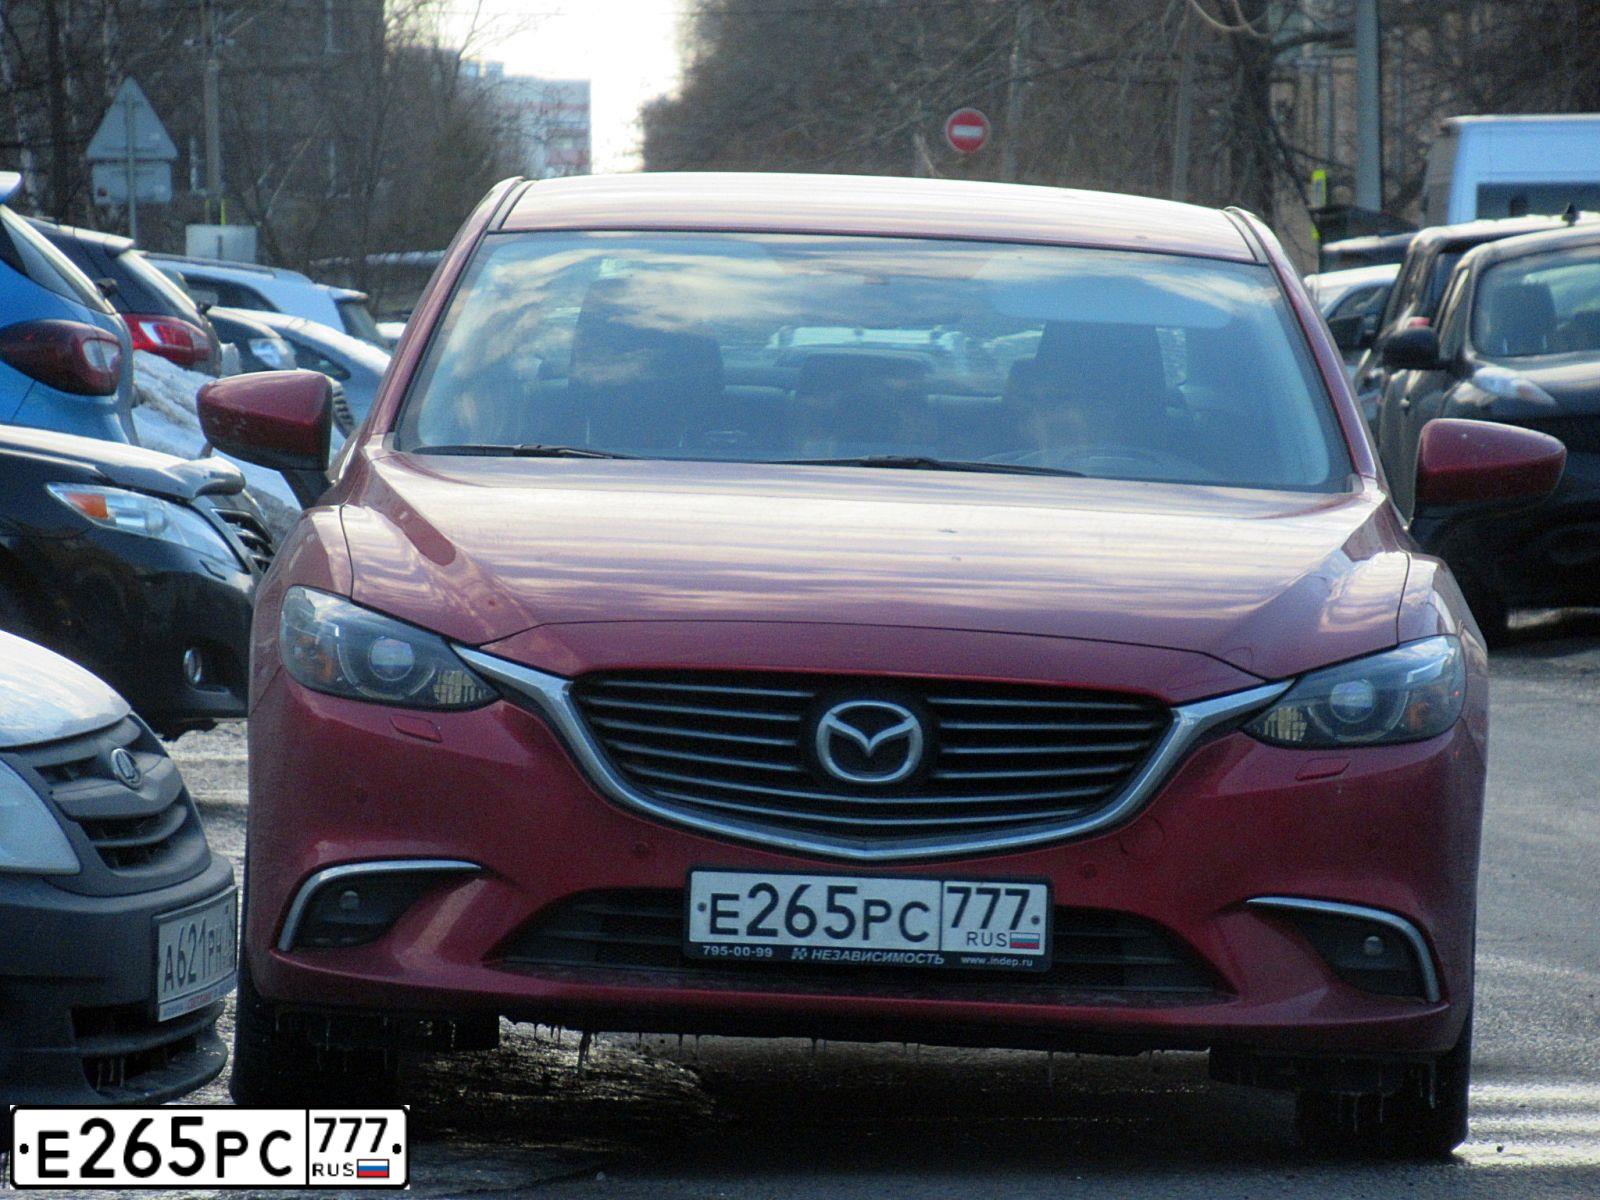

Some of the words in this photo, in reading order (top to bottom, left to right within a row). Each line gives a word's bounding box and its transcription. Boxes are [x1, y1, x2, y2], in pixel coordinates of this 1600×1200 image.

[709, 881, 931, 943] E265PC
[946, 886, 1031, 931] 777
[966, 931, 1008, 947] RUS
[702, 945, 773, 958] 795-00-99
[811, 948, 945, 966] НЕЗАВИСИМОСТЬ
[960, 955, 1034, 968] www.indep.ru
